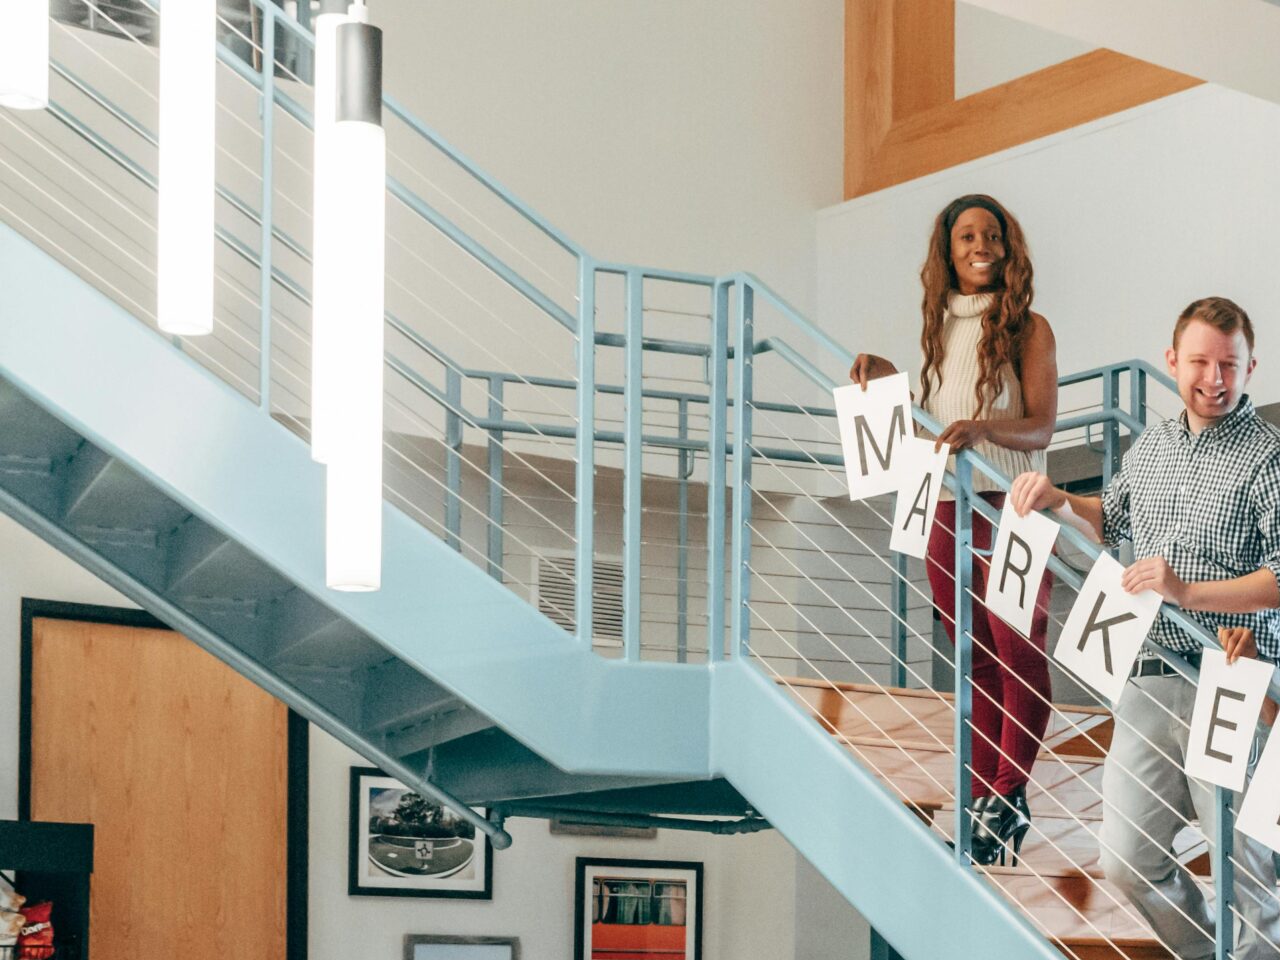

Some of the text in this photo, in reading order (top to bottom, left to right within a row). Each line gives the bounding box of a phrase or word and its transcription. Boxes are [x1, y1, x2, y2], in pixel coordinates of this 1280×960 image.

[902, 472, 932, 536] A
[999, 531, 1033, 609] R
[1076, 590, 1138, 677] K
[1205, 686, 1246, 763] E
